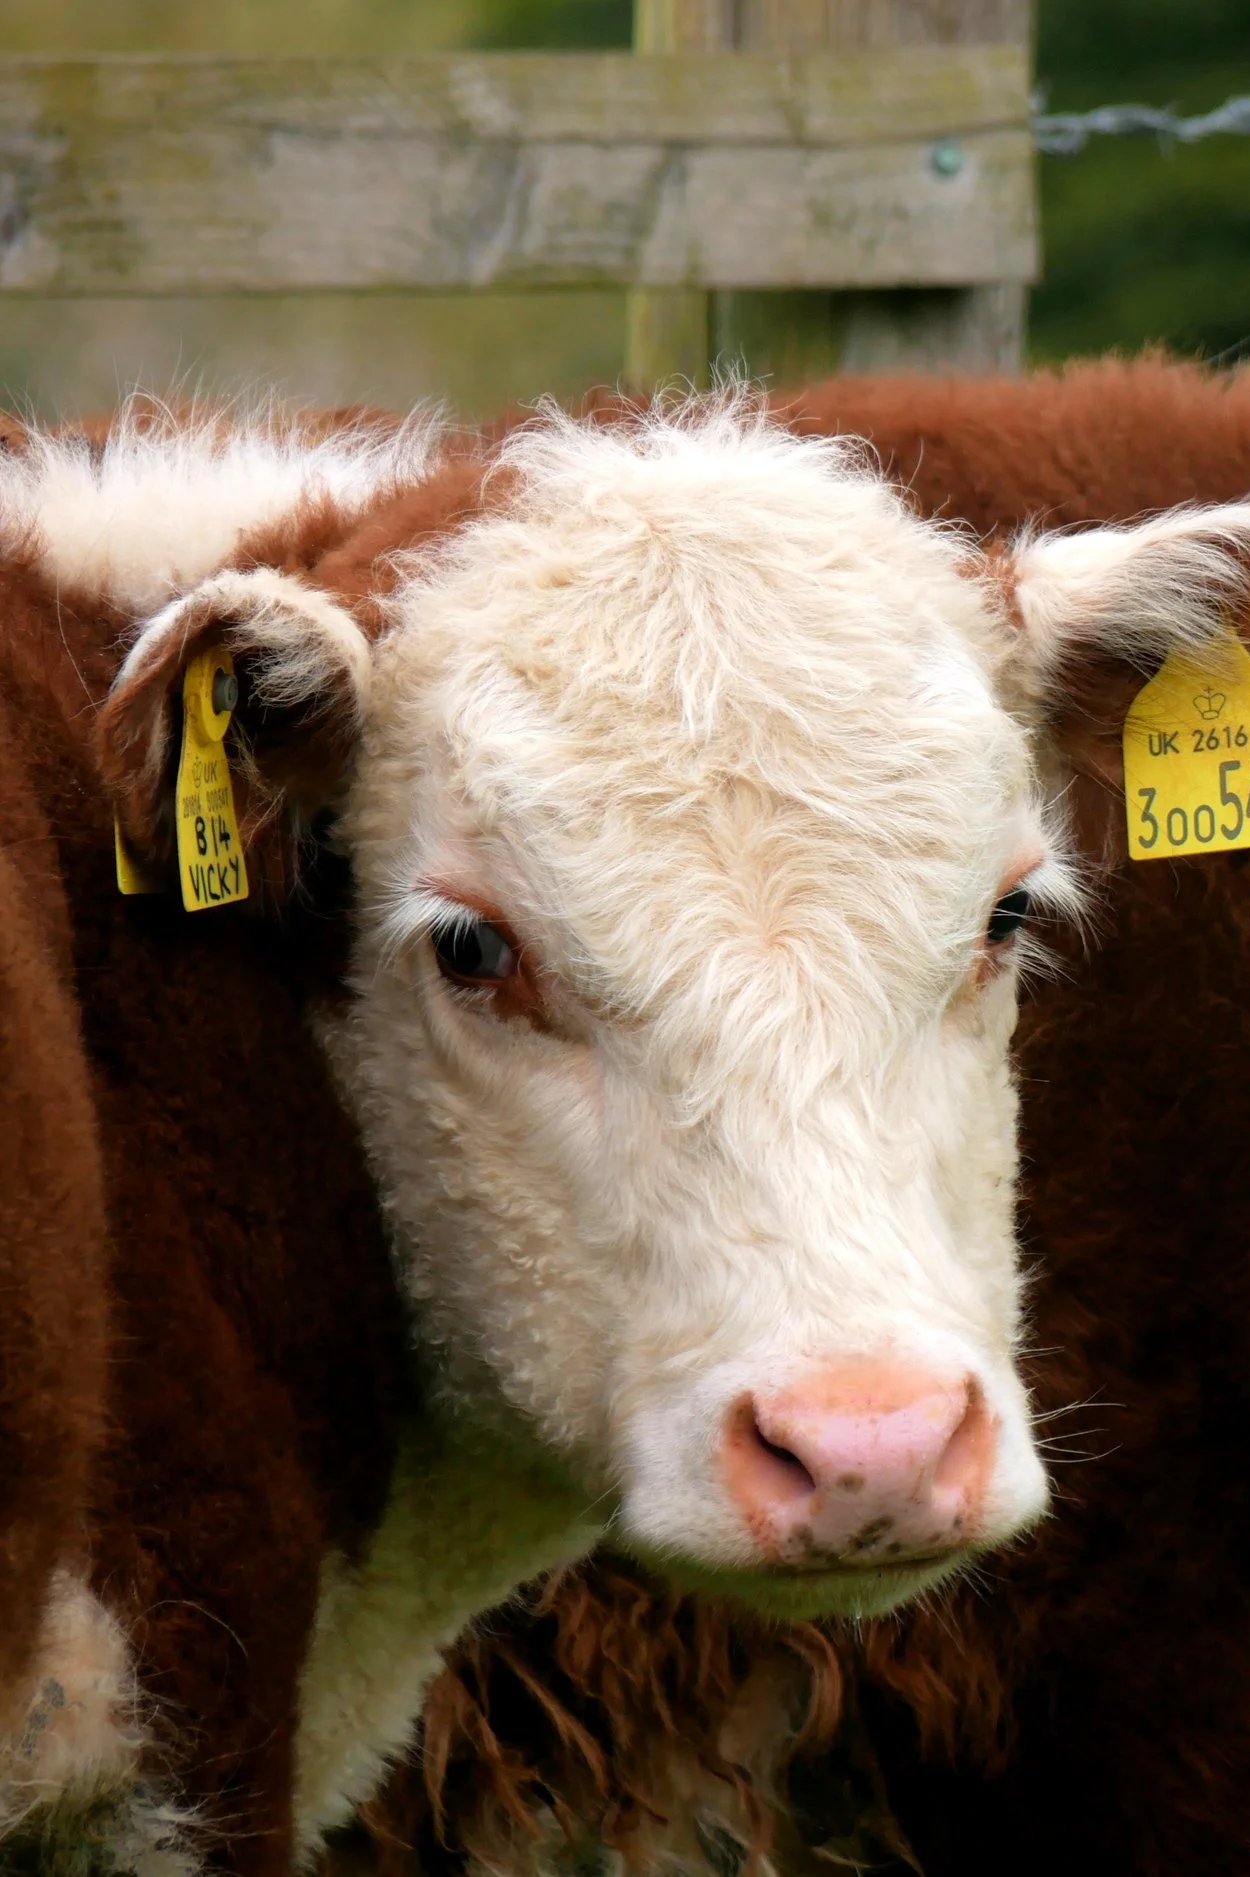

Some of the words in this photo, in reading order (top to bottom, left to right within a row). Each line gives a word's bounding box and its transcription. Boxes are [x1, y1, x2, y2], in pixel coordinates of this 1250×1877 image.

[1148, 732, 1181, 757] UK
[204, 762, 218, 783] UK
[189, 855, 240, 904] VICKY
